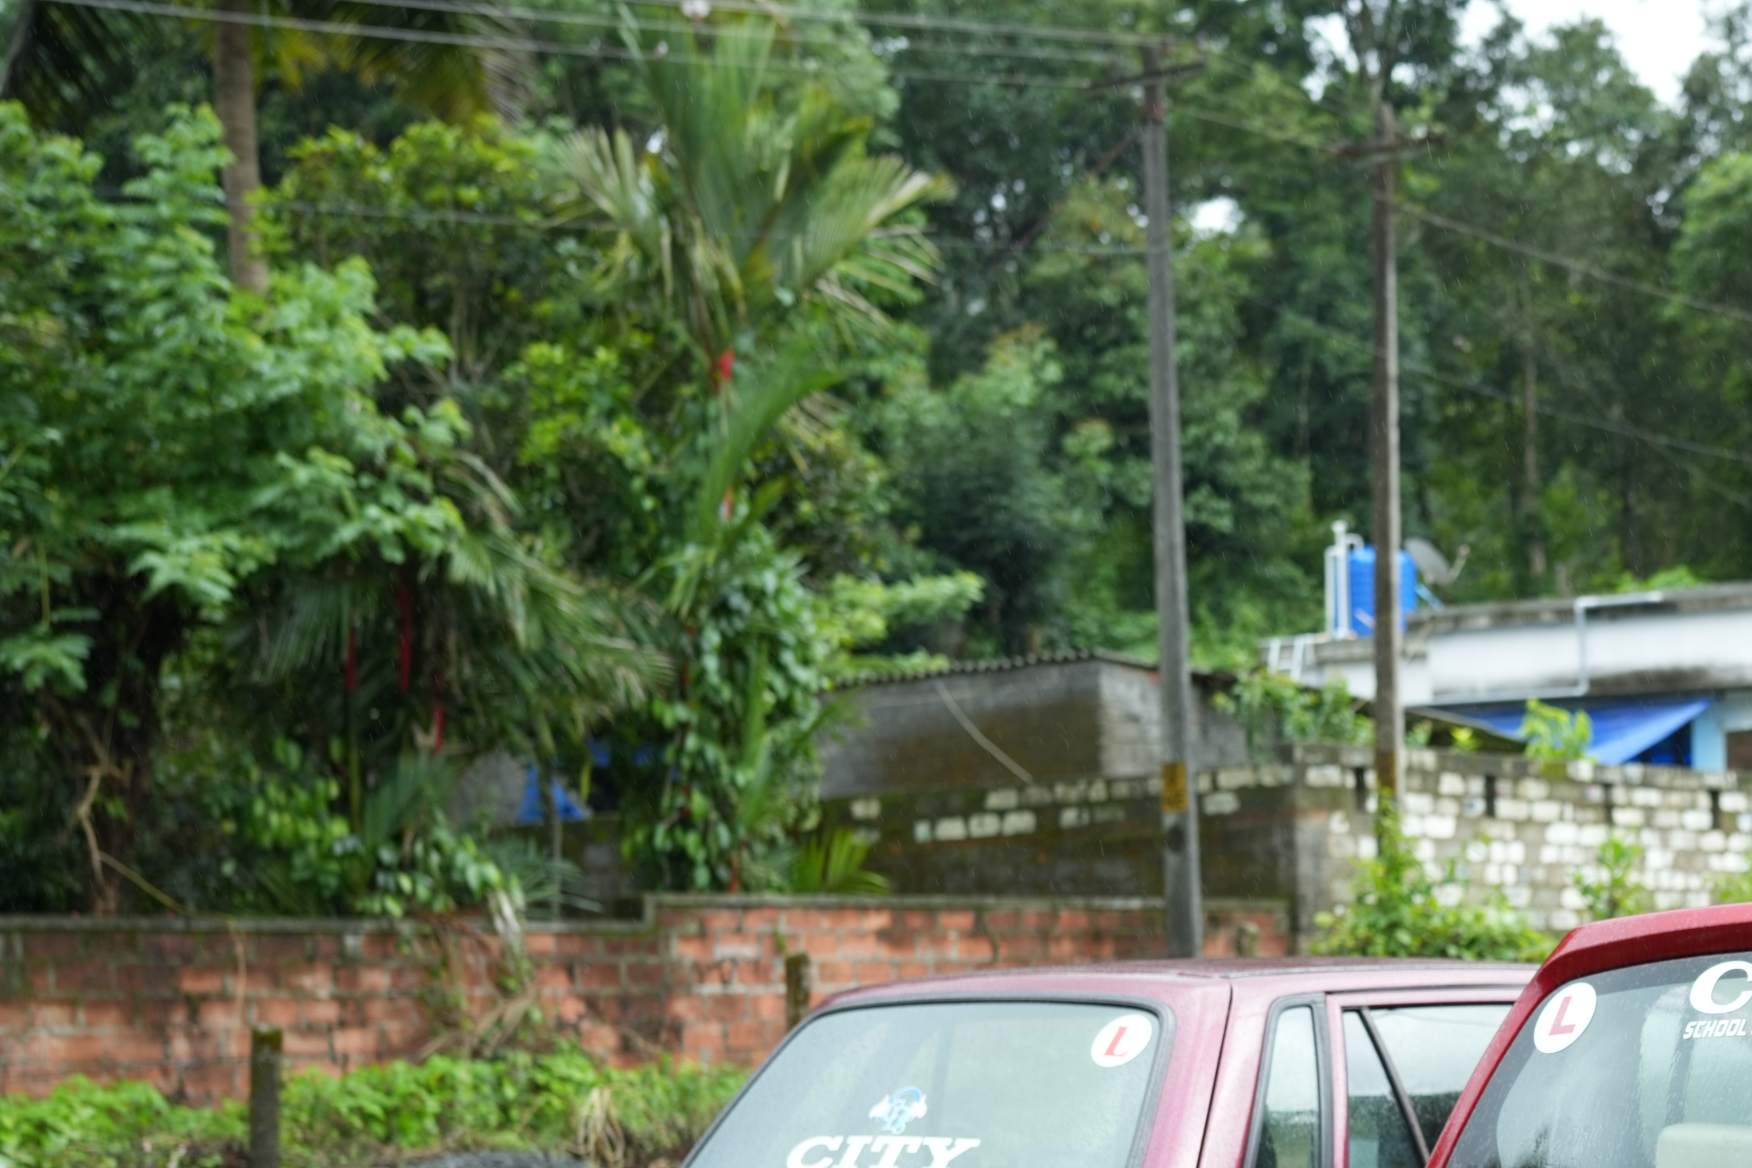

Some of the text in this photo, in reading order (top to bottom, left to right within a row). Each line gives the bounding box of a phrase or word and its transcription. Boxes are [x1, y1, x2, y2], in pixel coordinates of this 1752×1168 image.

[1548, 996, 1577, 1036] L
[1683, 1017, 1747, 1040] SCHOOL
[1103, 1026, 1129, 1057] L
